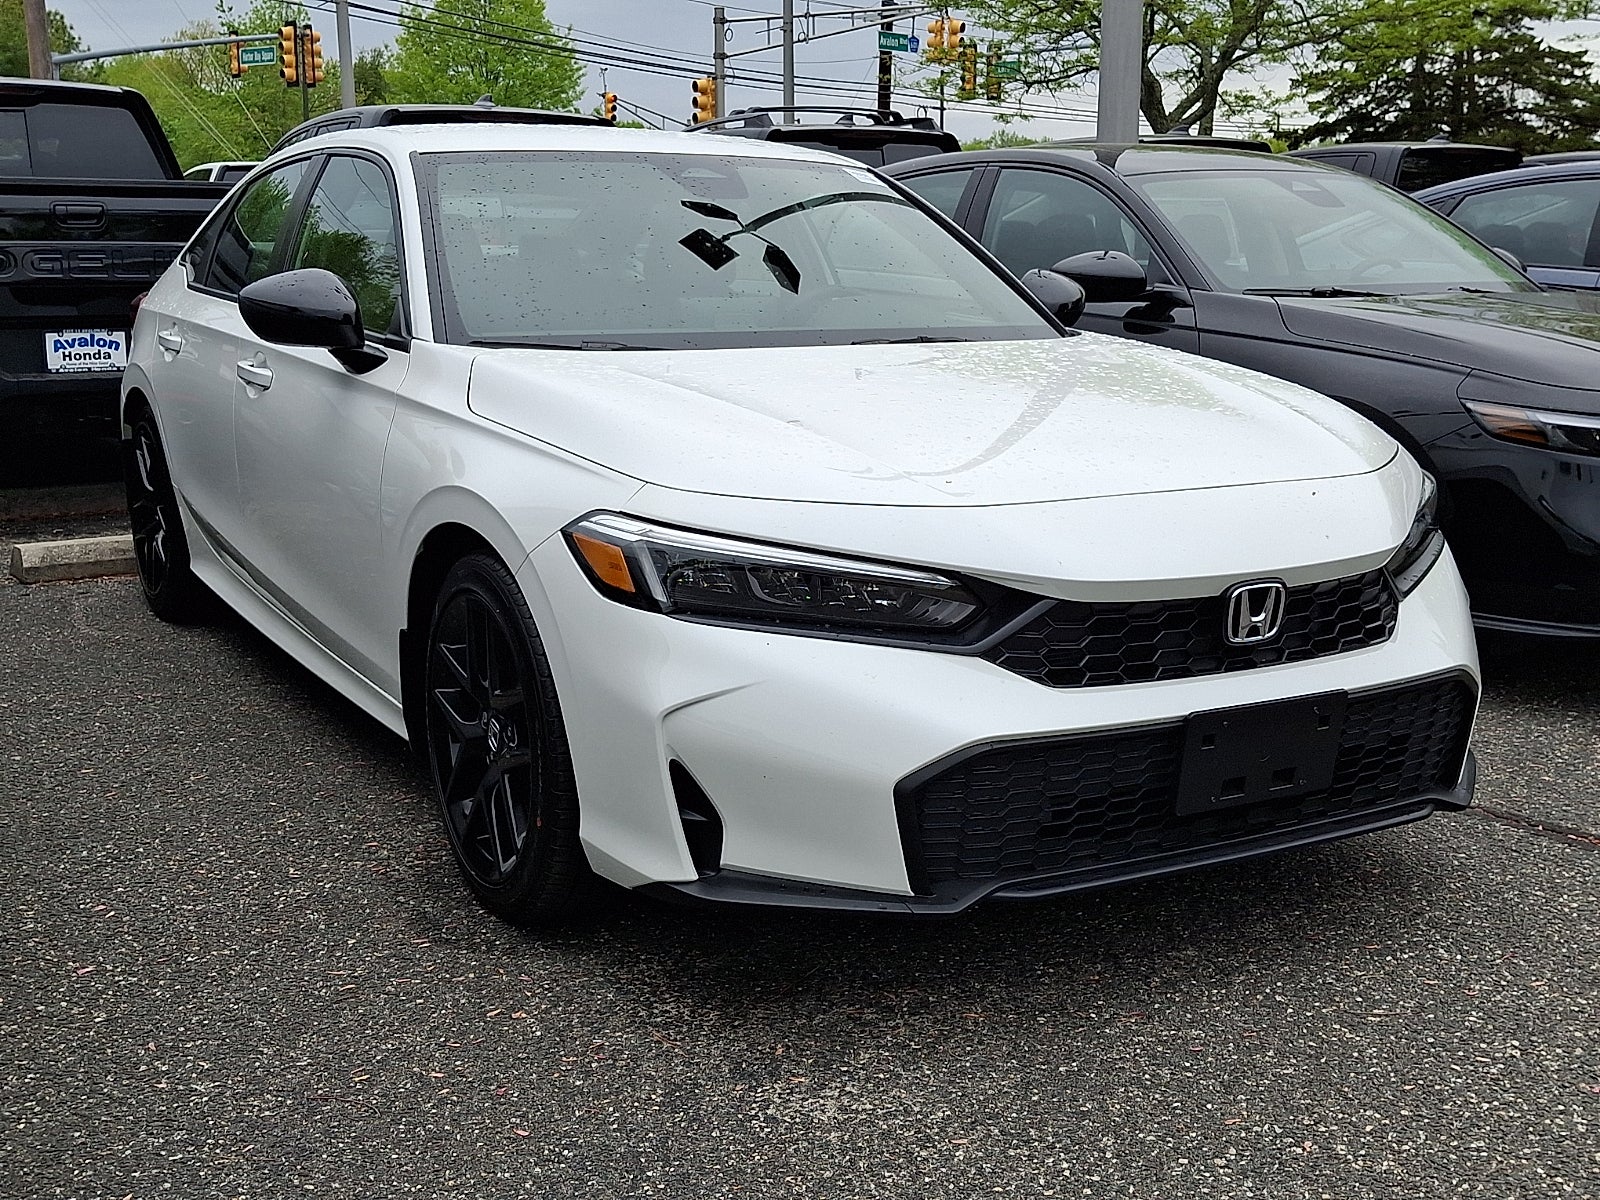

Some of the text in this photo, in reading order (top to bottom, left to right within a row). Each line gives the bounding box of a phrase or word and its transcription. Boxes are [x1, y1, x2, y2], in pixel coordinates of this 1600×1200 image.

[880, 35, 898, 47] Avalon
[54, 334, 120, 353] Avalon
[62, 349, 112, 361] Honda
